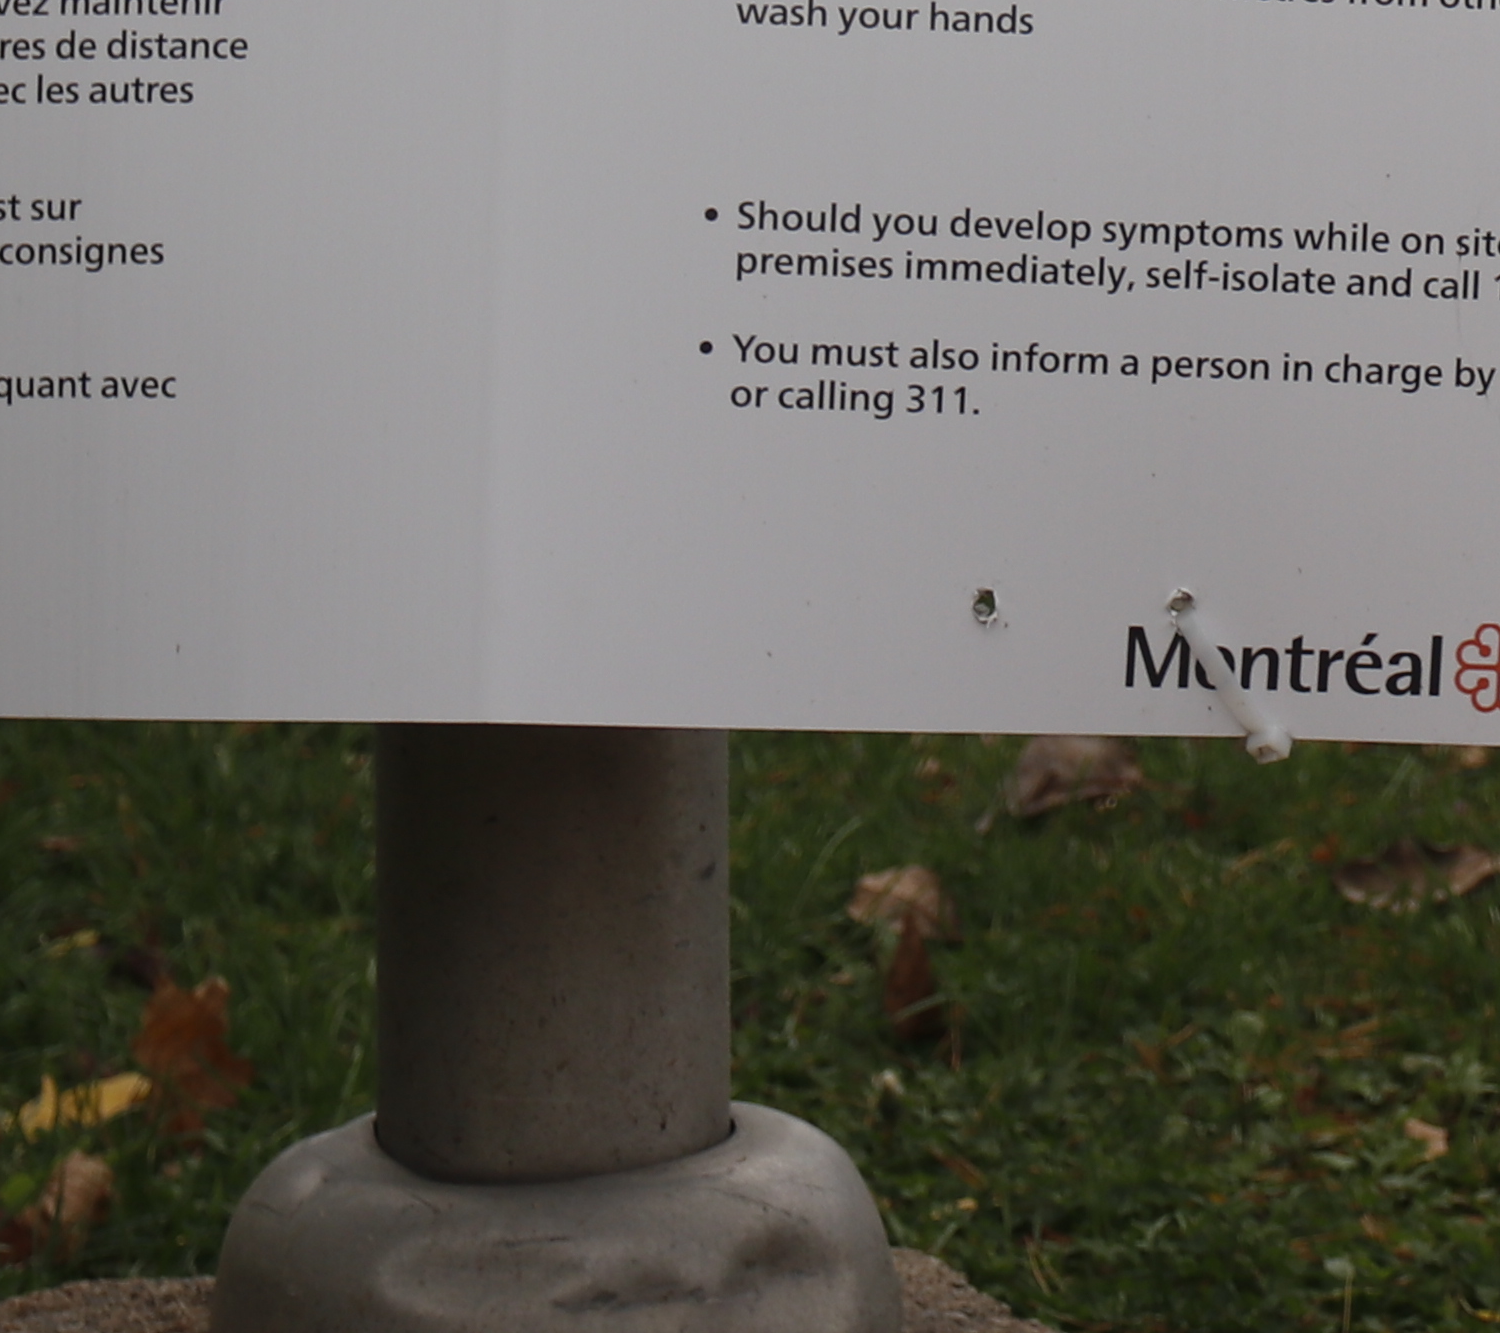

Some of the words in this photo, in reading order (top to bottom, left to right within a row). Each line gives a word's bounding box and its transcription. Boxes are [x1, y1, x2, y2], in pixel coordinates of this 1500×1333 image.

[837, 6, 921, 37] your
[929, 0, 1035, 36] hands
[54, 28, 98, 61] de
[106, 28, 249, 61] distance
[36, 72, 81, 105] les
[87, 76, 195, 105] autres
[30, 198, 83, 222] sur
[737, 199, 862, 235] Should
[871, 212, 939, 243] you
[949, 206, 1093, 250] develop
[1101, 219, 1284, 254] symptoms
[1293, 220, 1391, 254] while
[1400, 231, 1445, 256] on
[735, 247, 894, 283] premises
[904, 249, 1136, 296] immediately,
[1145, 258, 1337, 296] self-isolate
[1345, 266, 1413, 299] and
[1422, 268, 1481, 301] call
[732, 333, 800, 365] You
[810, 340, 900, 369] must
[908, 338, 980, 372] also
[990, 341, 1110, 376] inform
[1119, 353, 1140, 377] a
[1150, 354, 1271, 386] person
[1282, 351, 1314, 383] in
[1324, 352, 1444, 395] charge
[1454, 356, 1497, 397] by
[728, 382, 770, 410] or
[776, 378, 896, 422] calling
[904, 382, 982, 417] 311.
